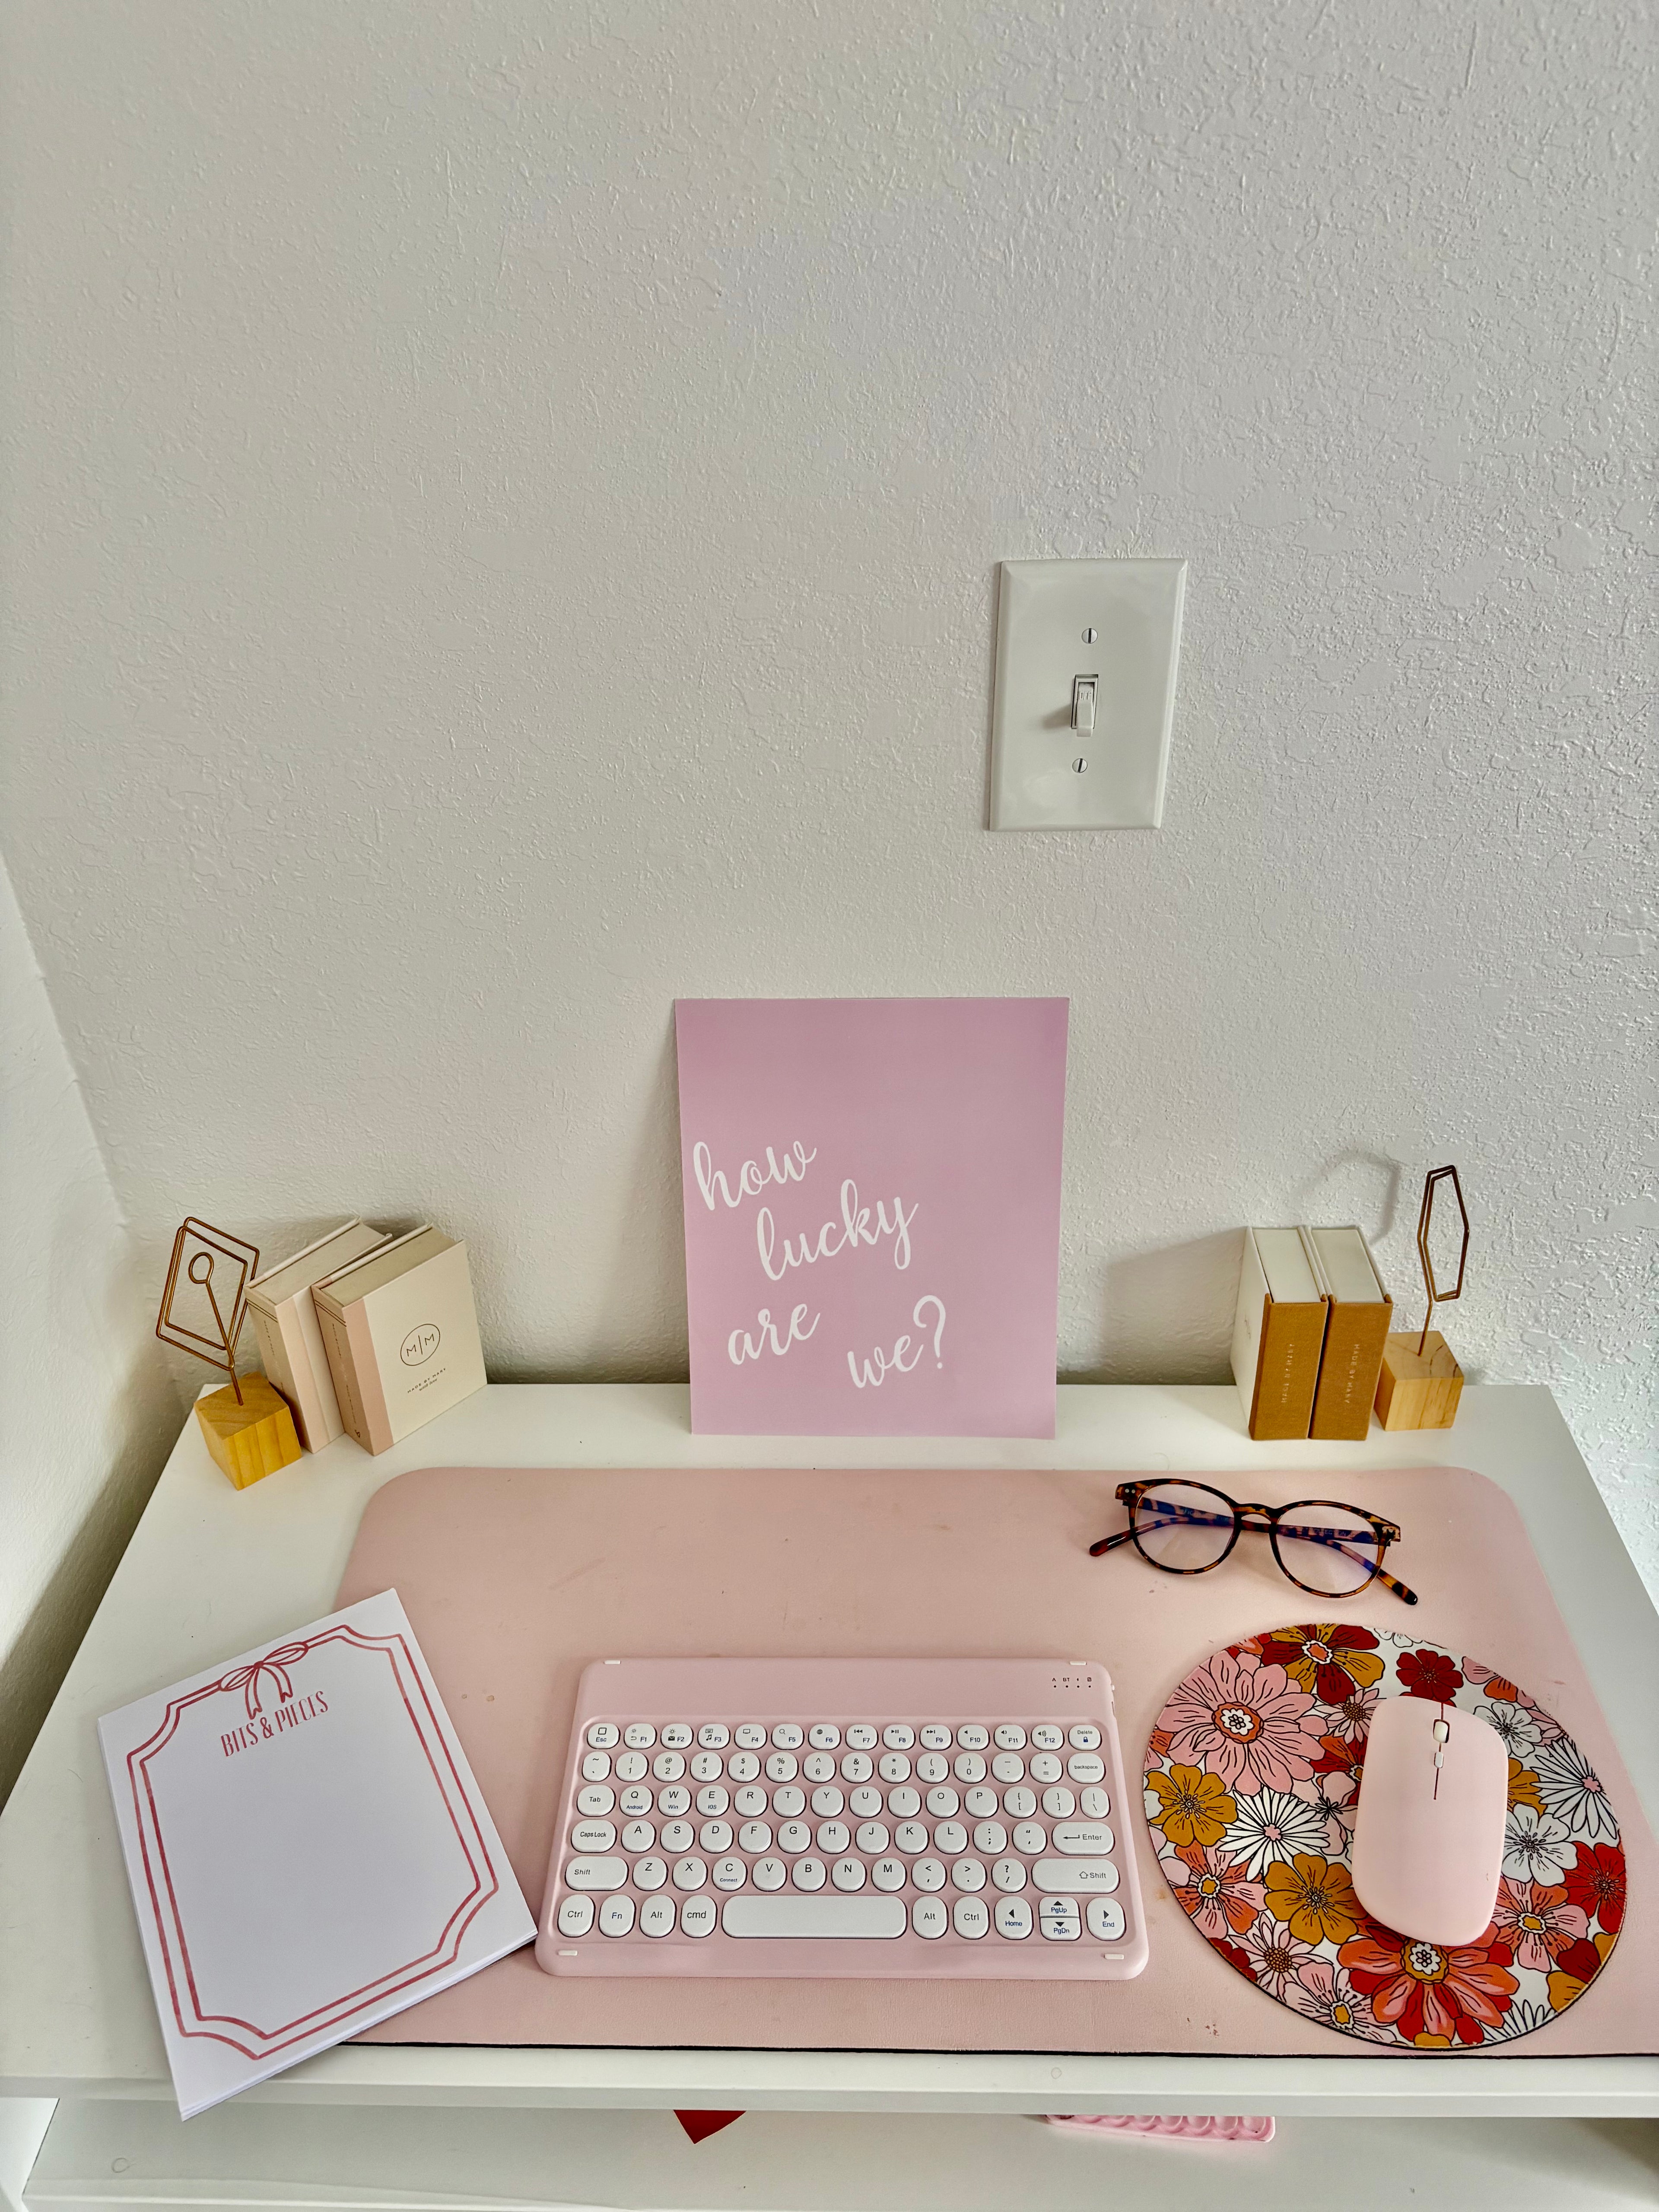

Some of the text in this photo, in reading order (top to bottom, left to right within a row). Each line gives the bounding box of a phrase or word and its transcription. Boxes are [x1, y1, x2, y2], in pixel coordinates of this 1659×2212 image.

[693, 1141, 817, 1211] how
[756, 1179, 919, 1281] lucky
[728, 1294, 946, 1388] are we?
[221, 1691, 328, 1757] BITS & PIECES
[631, 1791, 639, 1799] Q
[634, 1825, 642, 1834] A
[674, 1826, 681, 1834] S
[712, 1826, 720, 1834] D
[751, 1826, 757, 1834] F
[789, 1826, 798, 1834] G
[829, 1827, 836, 1835] H
[868, 1827, 874, 1835] J
[906, 1827, 914, 1835] K
[947, 1827, 954, 1835] L
[645, 1862, 653, 1871] Z
[685, 1863, 693, 1872] X
[725, 1863, 733, 1872] C
[766, 1863, 773, 1872] V
[805, 1864, 812, 1872] B
[844, 1864, 852, 1873] N
[884, 1864, 892, 1873] M
[1004, 1865, 1009, 1873] ?
[687, 1910, 706, 1919] cmd
